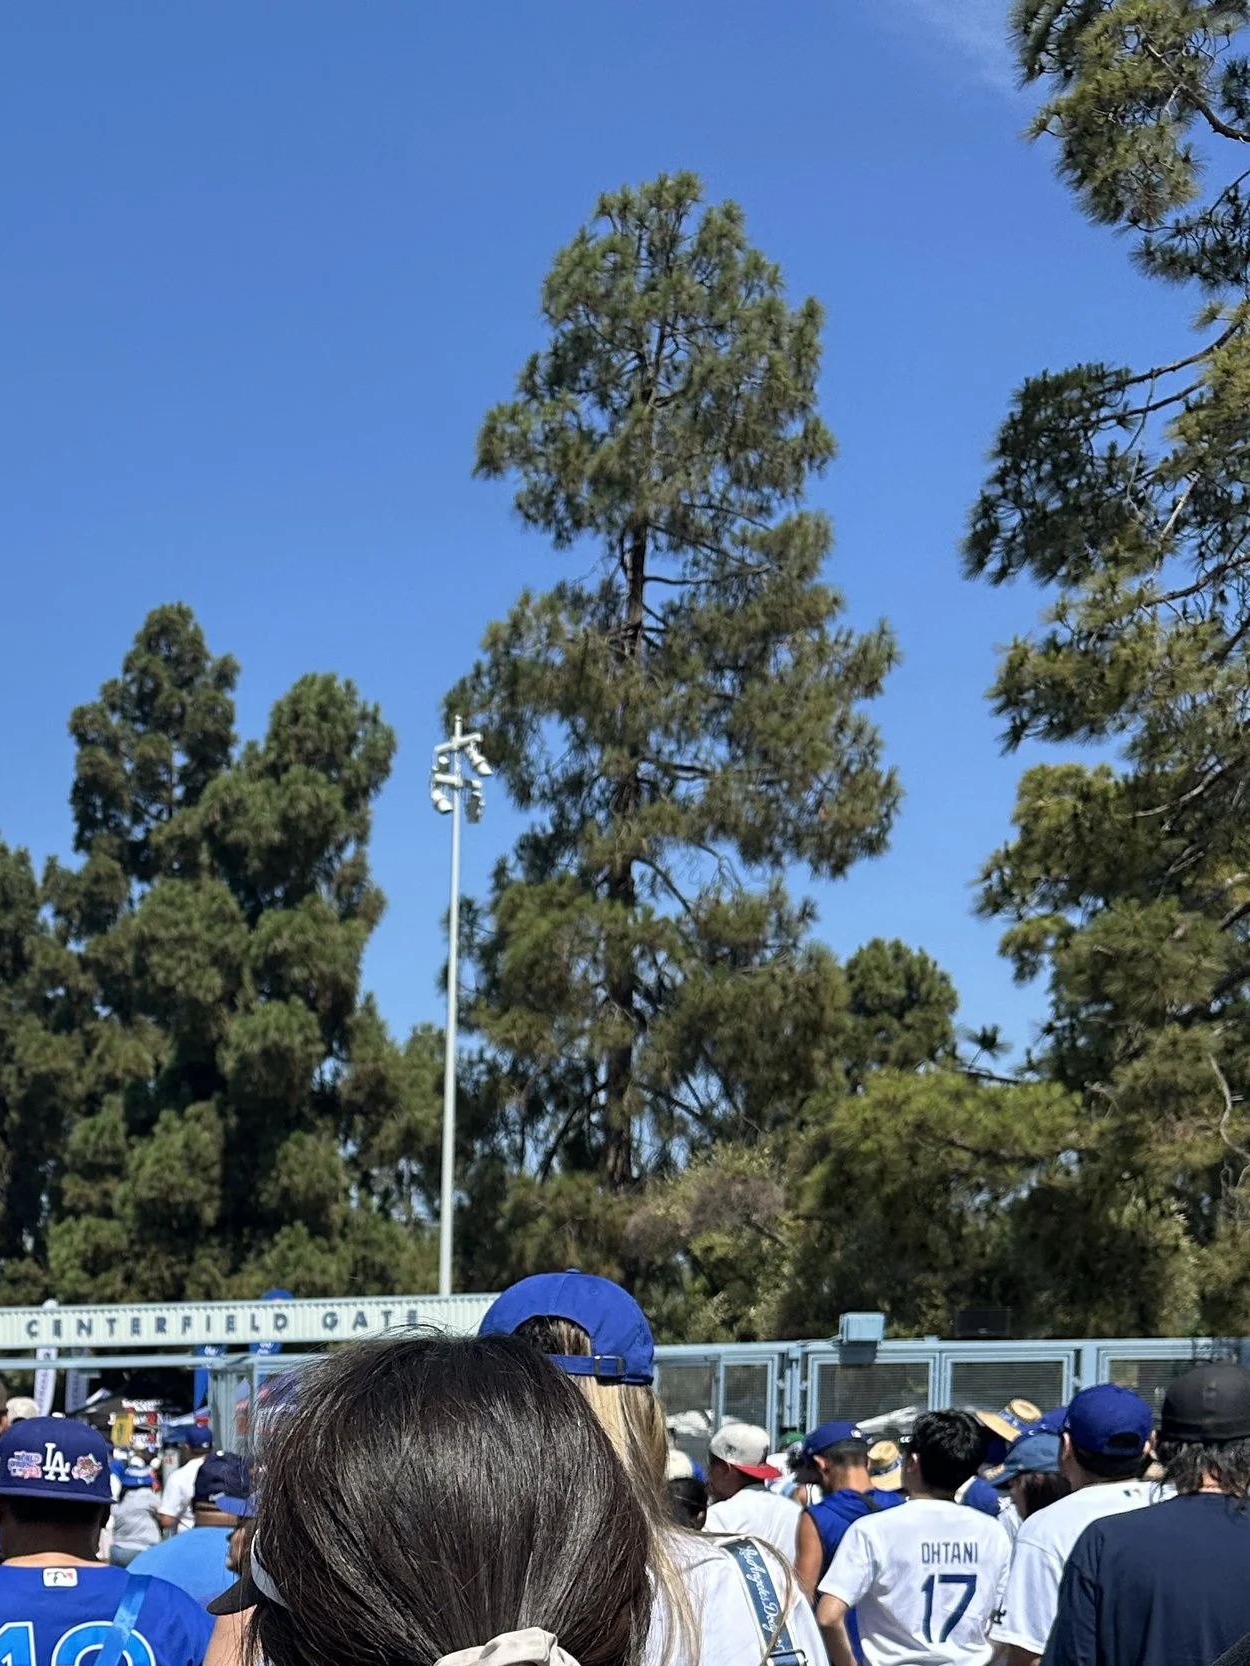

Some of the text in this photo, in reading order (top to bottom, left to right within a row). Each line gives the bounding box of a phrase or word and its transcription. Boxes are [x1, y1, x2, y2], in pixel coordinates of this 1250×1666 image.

[26, 1310, 419, 1338] CENTERFIELD GATE
[43, 1443, 70, 1481] LA
[921, 1541, 979, 1564] OHTANI
[762, 1602, 786, 1650] Dodgrs
[921, 1574, 977, 1643] 17
